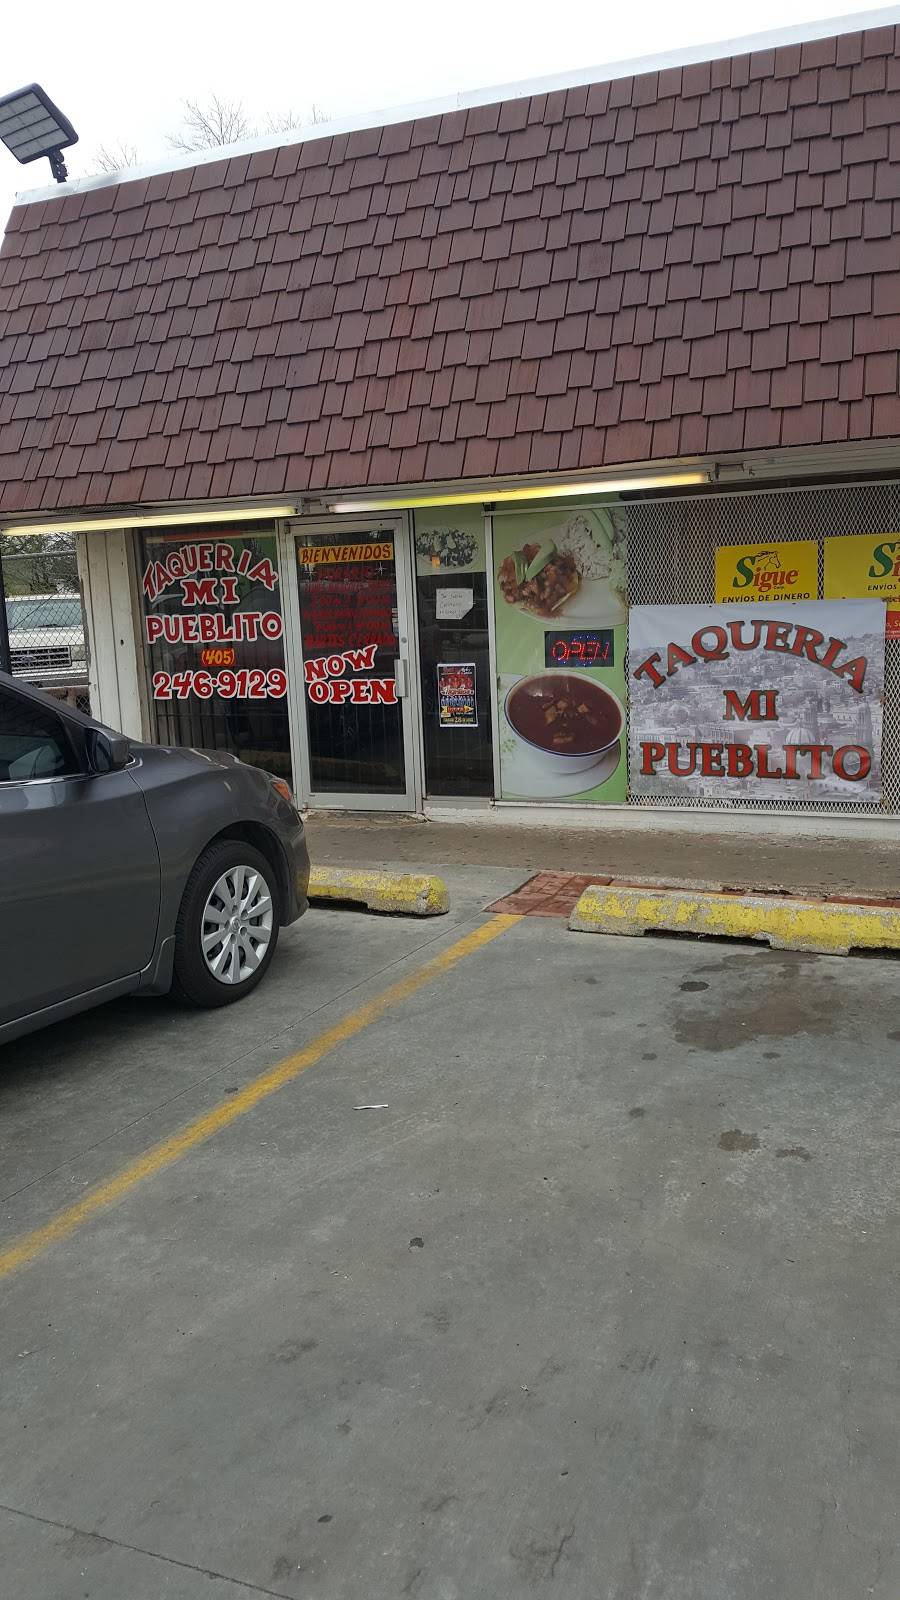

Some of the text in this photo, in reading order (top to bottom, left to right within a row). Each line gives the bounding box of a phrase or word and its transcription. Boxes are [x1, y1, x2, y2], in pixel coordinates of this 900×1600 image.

[301, 543, 391, 564] BIENVENIDOS
[868, 541, 900, 583] Si
[143, 543, 279, 602] TAQUERIA
[732, 555, 799, 593] Sigue
[181, 577, 240, 606] MI
[758, 594, 771, 602] DE
[773, 592, 810, 601] DINERO
[146, 611, 283, 644] PUEBLITO
[201, 649, 235, 665] (405)
[304, 644, 378, 683] NOW
[552, 639, 609, 661] OPEN
[633, 619, 869, 693] TAQUERIA
[308, 678, 398, 705] OPEN
[722, 689, 780, 721] MI
[640, 741, 872, 781] PUEBLITO
